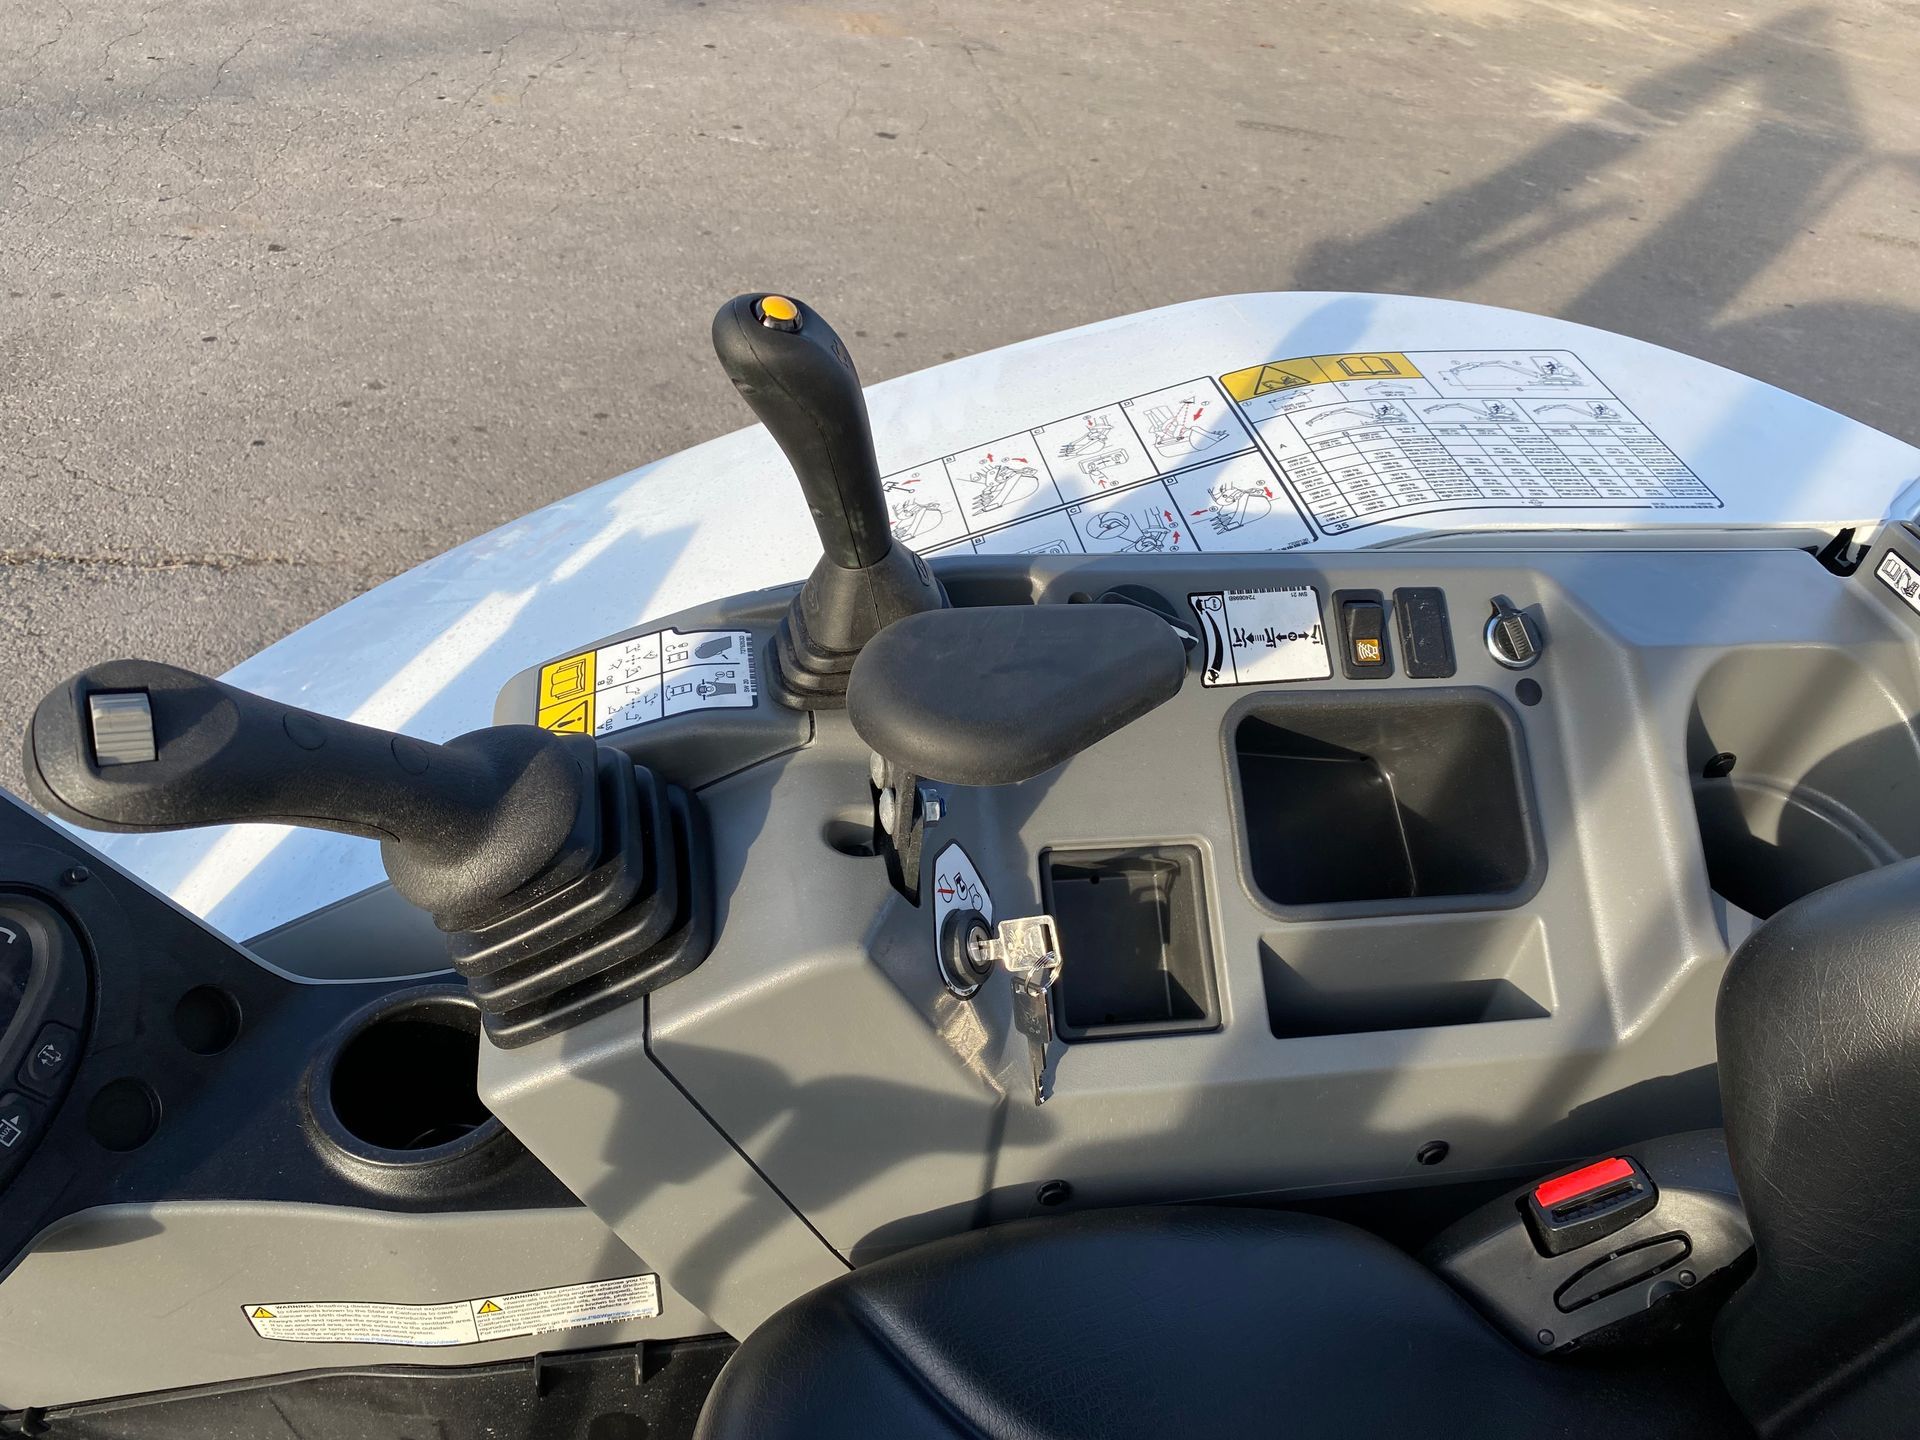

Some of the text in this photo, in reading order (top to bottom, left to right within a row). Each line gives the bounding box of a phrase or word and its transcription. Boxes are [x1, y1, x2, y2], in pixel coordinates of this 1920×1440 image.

[1335, 522, 1350, 530] 35
[606, 675, 614, 686] ISO
[605, 718, 613, 731] STD
